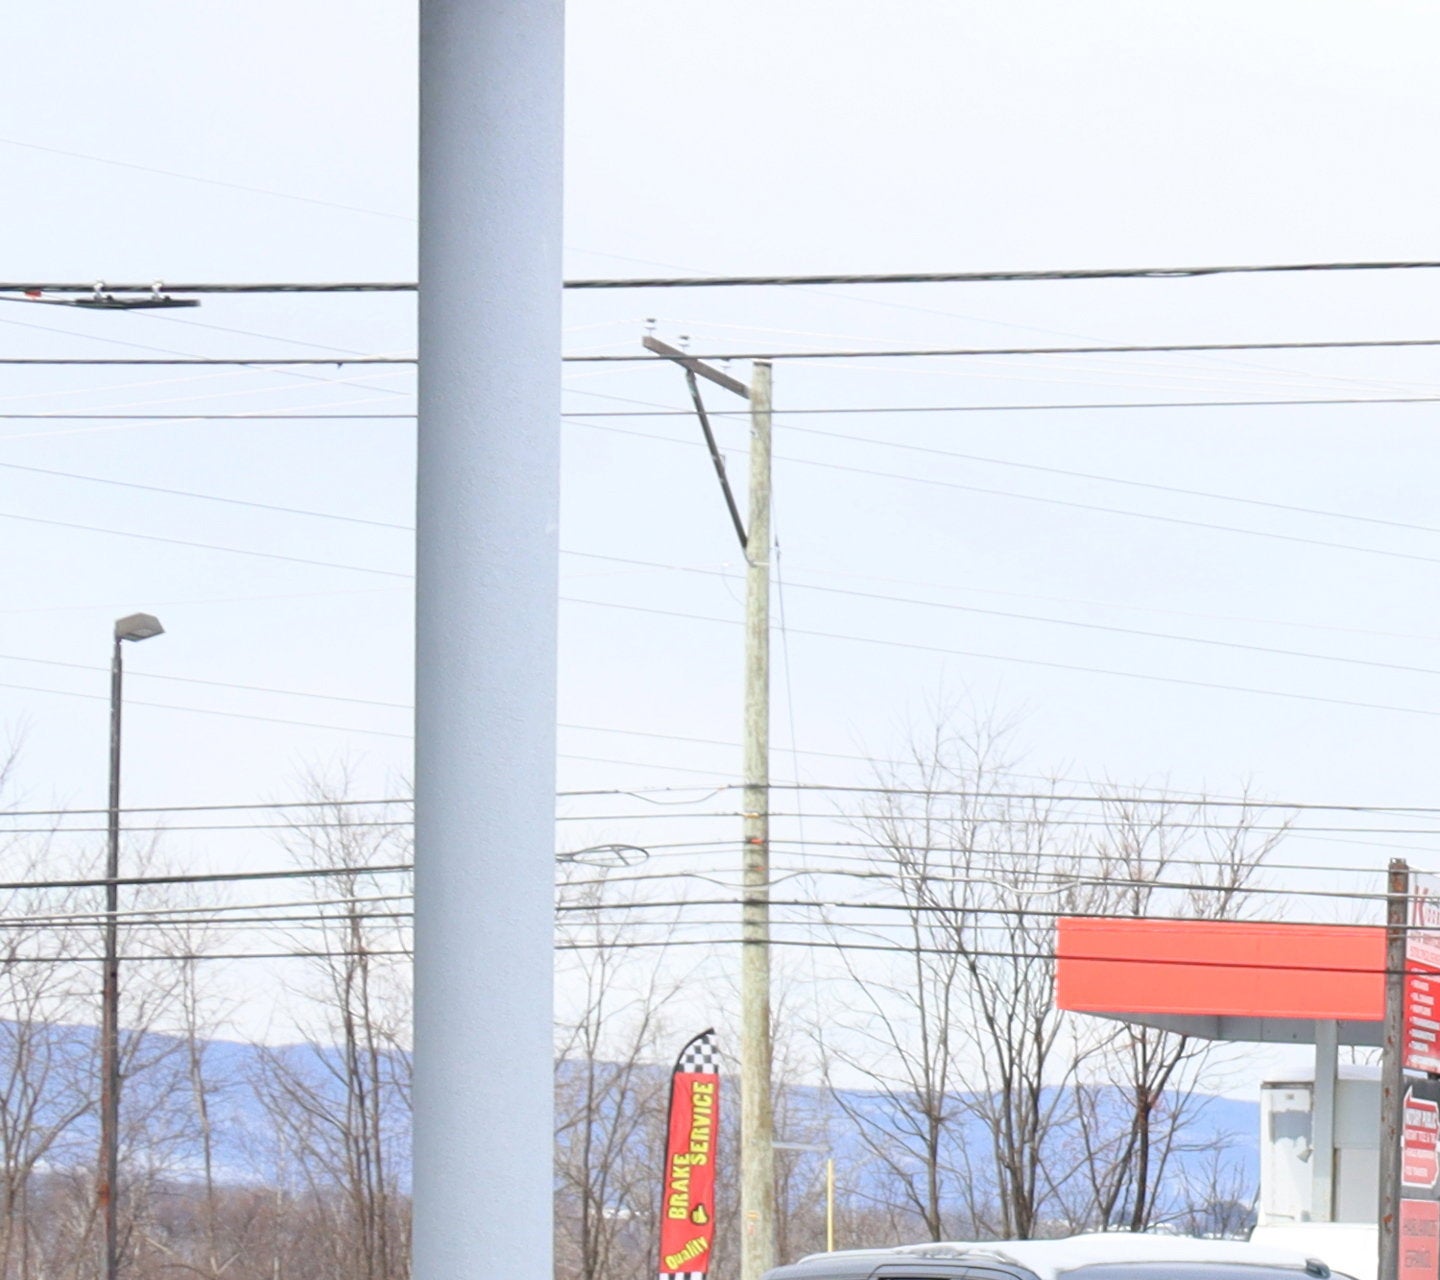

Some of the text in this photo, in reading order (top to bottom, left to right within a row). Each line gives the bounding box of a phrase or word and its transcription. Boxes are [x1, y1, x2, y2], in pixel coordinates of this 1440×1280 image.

[690, 1081, 714, 1165] SERVICE
[668, 1153, 690, 1220] BRAKE
[665, 1236, 709, 1270] Quality
